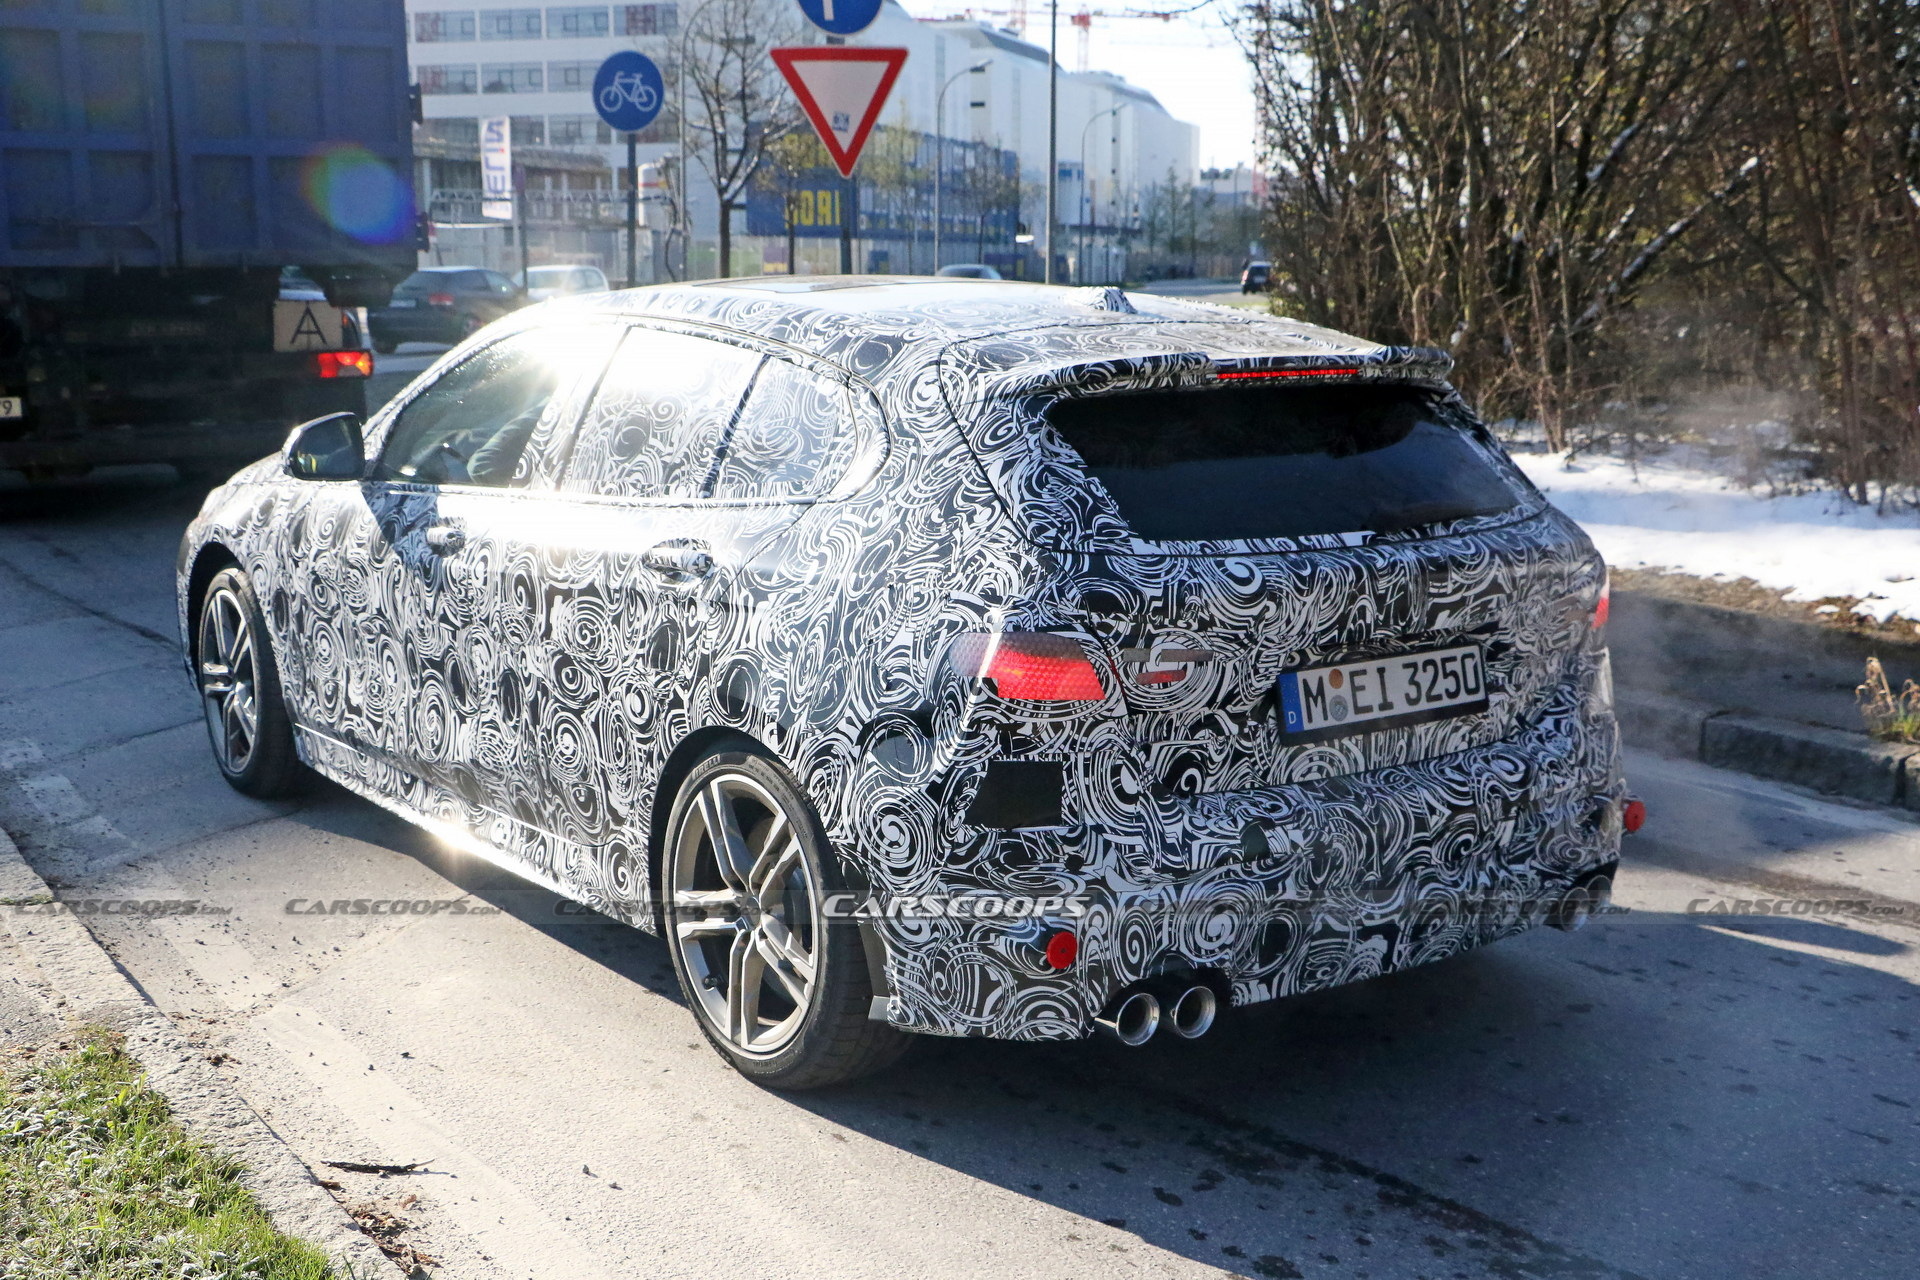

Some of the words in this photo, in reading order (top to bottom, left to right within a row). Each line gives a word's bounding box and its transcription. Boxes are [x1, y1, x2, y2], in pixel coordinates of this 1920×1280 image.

[289, 302, 328, 344] A
[1302, 675, 1328, 723] M
[1349, 667, 1394, 715] EI
[1402, 652, 1481, 706] 3250
[1288, 711, 1297, 724] D
